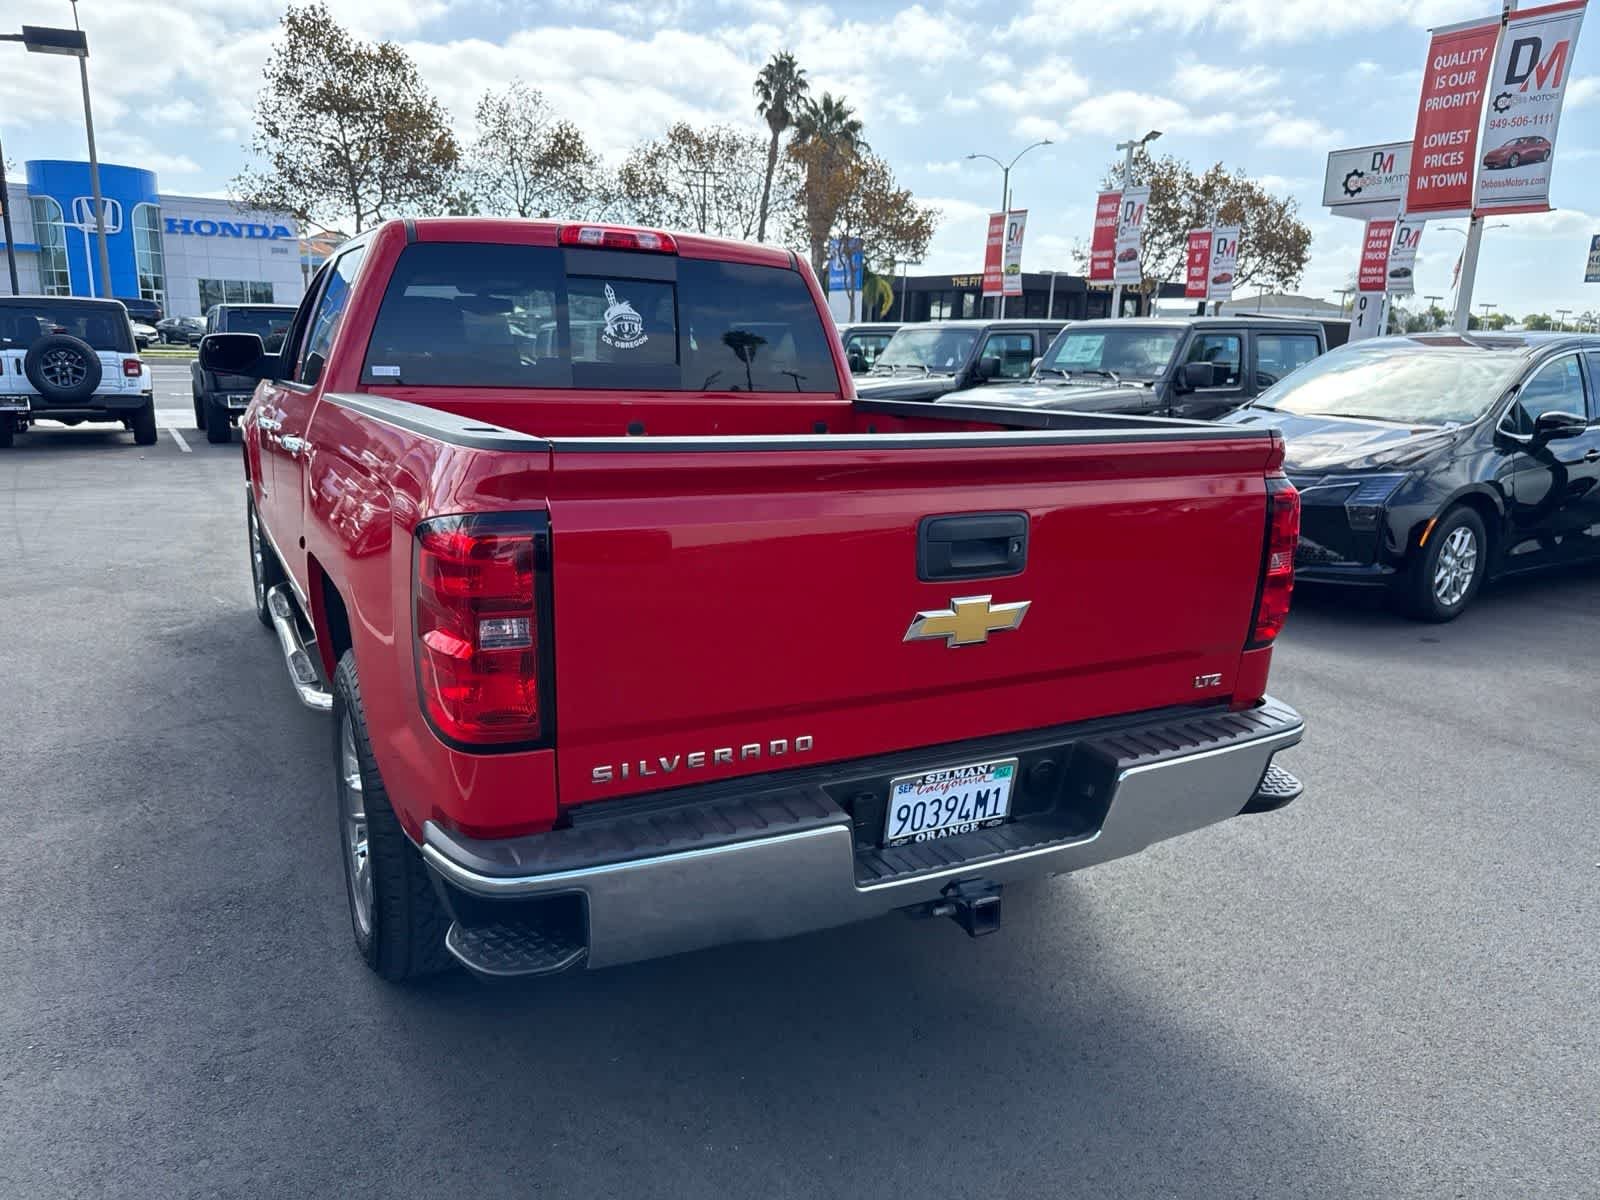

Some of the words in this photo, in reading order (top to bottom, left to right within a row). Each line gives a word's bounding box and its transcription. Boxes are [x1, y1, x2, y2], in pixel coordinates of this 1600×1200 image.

[1433, 47, 1488, 71] QUALITY
[1504, 36, 1570, 92] DM
[1435, 75, 1446, 90] IS
[1448, 70, 1476, 87] OUR
[1425, 90, 1480, 112] PRIORITY
[1529, 92, 1560, 103] MOTORS
[1489, 113, 1554, 130] 949-506-1111
[1423, 129, 1471, 149] LOWEST
[1371, 152, 1395, 175] DM
[1423, 151, 1464, 169] PRICES
[1416, 175, 1428, 190] IN
[1430, 171, 1467, 189] TOWN
[164, 217, 292, 240] HONDA
[952, 276, 968, 287] THE
[614, 334, 649, 349] OBREGON
[1194, 673, 1223, 689] LTZ
[592, 735, 813, 783] SILVERADO
[917, 774, 987, 796] California
[925, 765, 987, 785] SELMAN
[898, 783, 914, 795] SEP
[894, 787, 1001, 836] 90394M1
[915, 822, 980, 844] ORANGE
